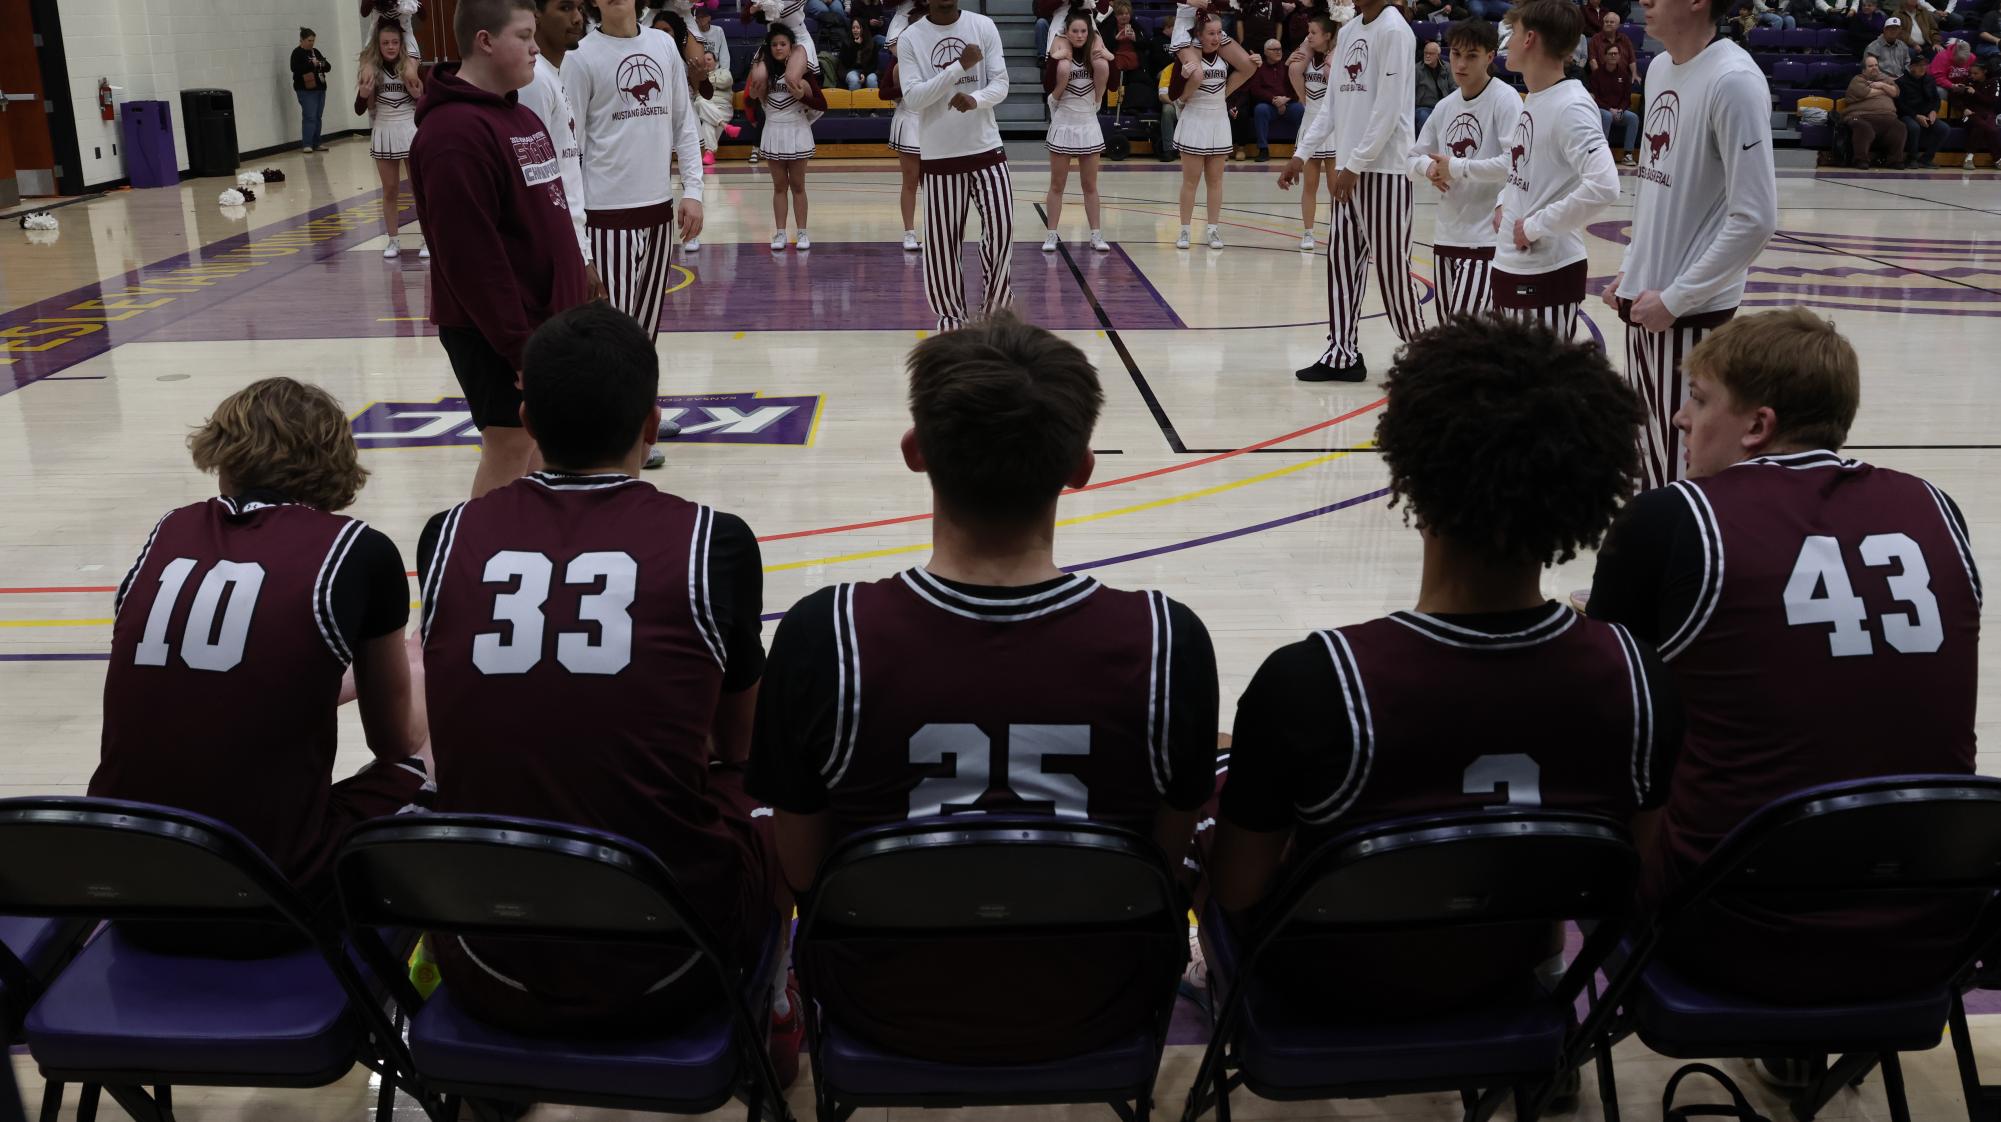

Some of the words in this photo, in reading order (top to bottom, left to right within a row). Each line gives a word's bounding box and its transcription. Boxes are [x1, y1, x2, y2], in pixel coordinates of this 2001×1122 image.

[612, 108, 640, 120] MUSTANG
[640, 106, 669, 117] BASKETBALL
[134, 557, 266, 673] 10
[472, 549, 638, 676] 33
[1783, 532, 1945, 657] 43
[908, 723, 1091, 820] 25
